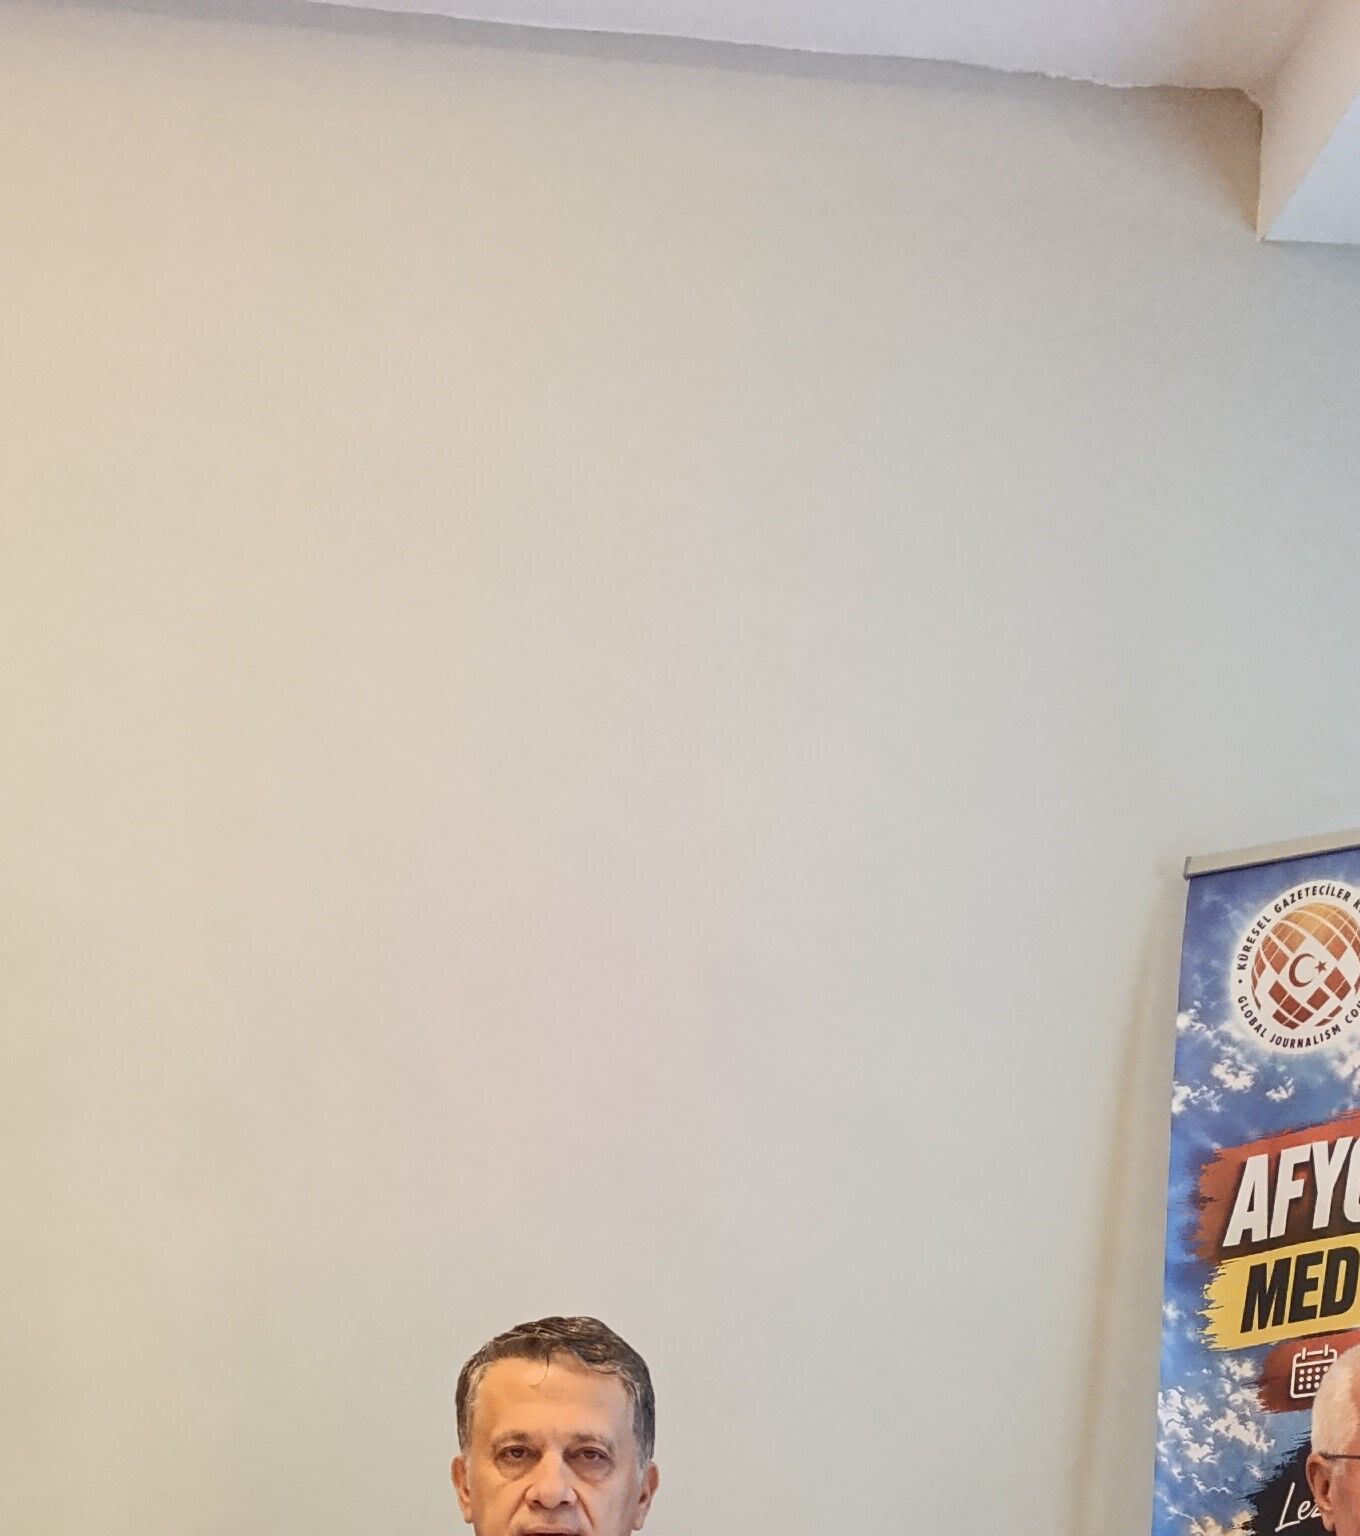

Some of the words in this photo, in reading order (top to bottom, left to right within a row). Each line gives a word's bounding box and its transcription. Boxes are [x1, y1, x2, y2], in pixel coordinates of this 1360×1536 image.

[1237, 914, 1272, 971] KÜRESEL
[1274, 882, 1352, 914] GAZETECİLER
[1237, 996, 1268, 1038] GLOBAL
[1269, 1023, 1342, 1049] JOURNALISM
